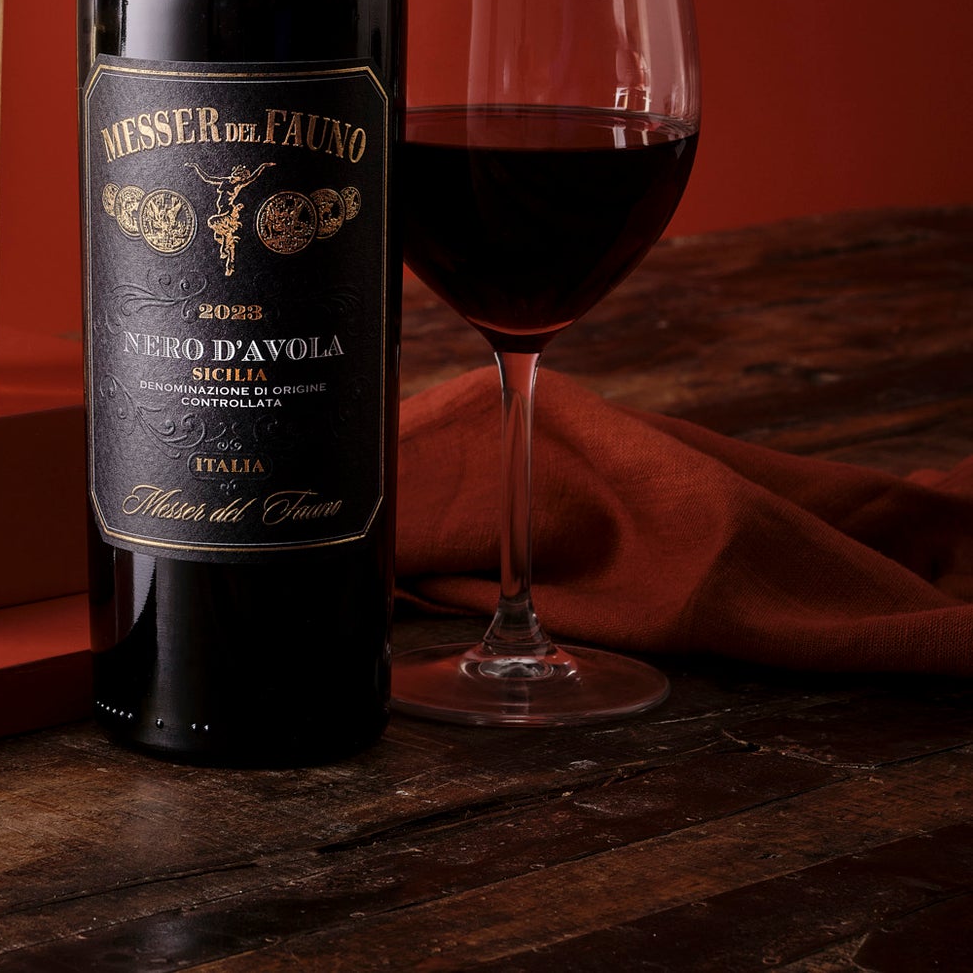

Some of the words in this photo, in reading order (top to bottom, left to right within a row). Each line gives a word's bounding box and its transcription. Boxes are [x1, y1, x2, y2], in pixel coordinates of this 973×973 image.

[100, 106, 223, 164] MESSER
[224, 122, 262, 144] DEL
[262, 108, 368, 164] FAUNO
[198, 303, 264, 321] 2023
[122, 330, 205, 363] NERO
[211, 334, 346, 363] D'AVOLA
[191, 366, 269, 383] SICILIA
[139, 380, 251, 397] DENOMINAZIONE
[253, 386, 269, 397] DI
[271, 382, 328, 396] ORIGINE
[180, 397, 283, 409] CONTROLLATA
[195, 457, 266, 474] ITALIA
[122, 484, 207, 523] Messer
[208, 497, 258, 524] del
[262, 488, 343, 526] Fauno
